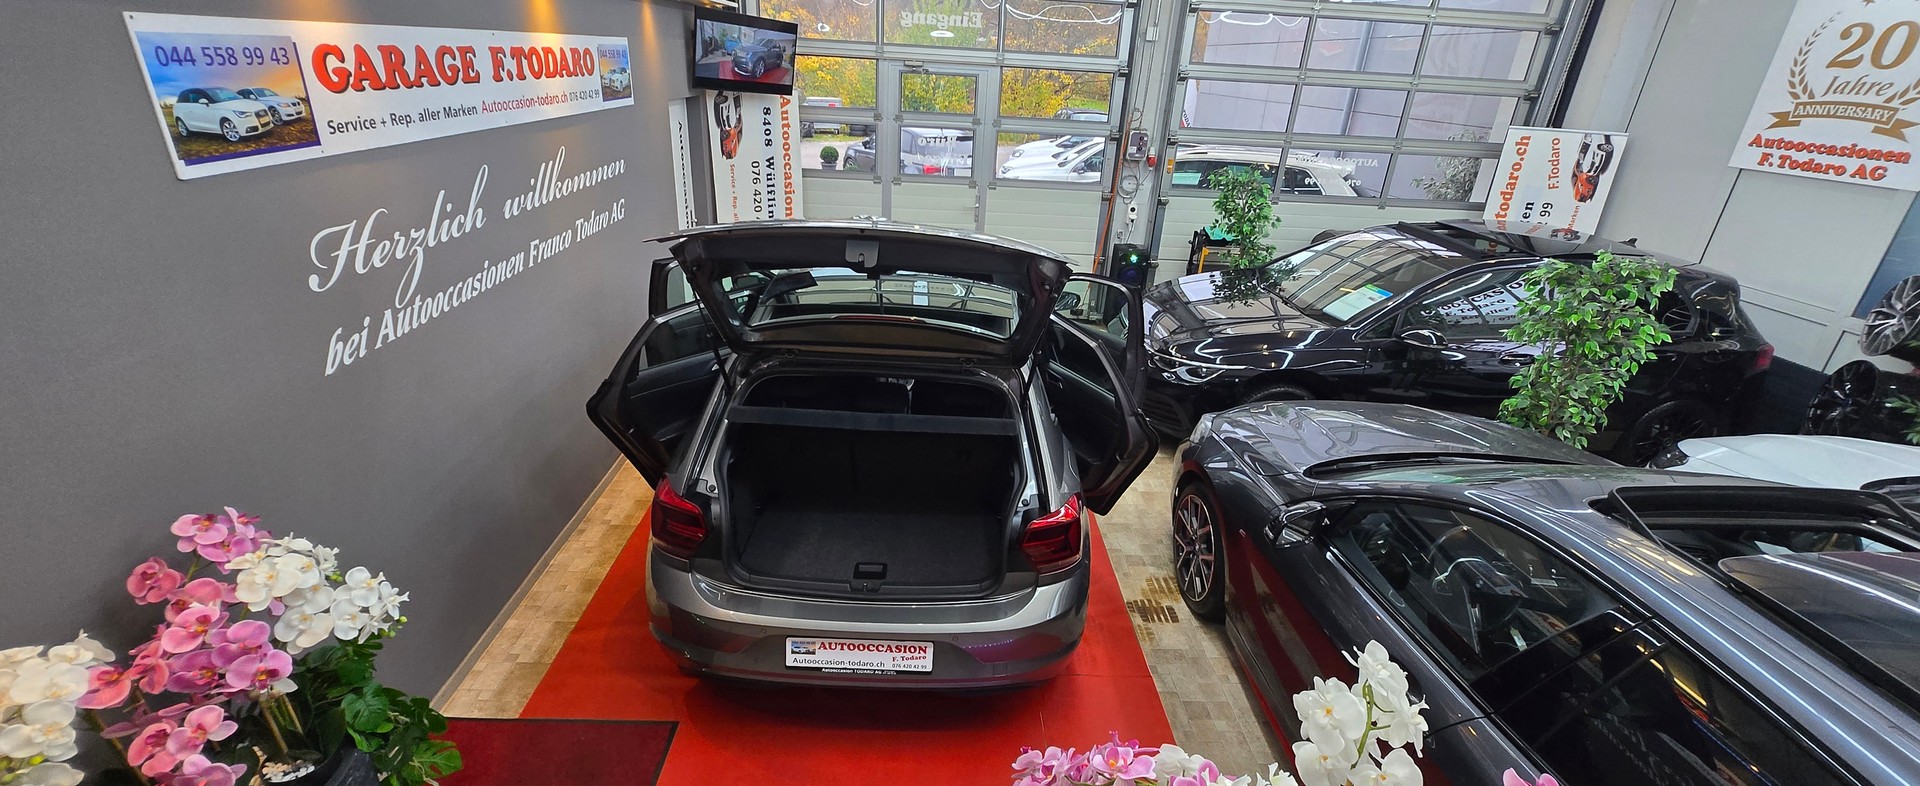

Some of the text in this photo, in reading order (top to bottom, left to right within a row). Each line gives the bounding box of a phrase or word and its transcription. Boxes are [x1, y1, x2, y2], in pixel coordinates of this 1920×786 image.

[155, 46, 291, 67] 044 558 99 43
[1826, 20, 1920, 70] 20
[311, 43, 595, 94] GARAGE F.TODARO
[1820, 74, 1894, 97] Jahre
[327, 115, 377, 135] Service
[380, 117, 387, 128] +
[390, 112, 416, 128] Rep.
[418, 108, 441, 123] aller
[443, 103, 478, 118] Marken
[482, 90, 568, 114] Autooccasion-todaro.ch
[569, 91, 578, 102] 076
[580, 90, 588, 100] 420
[588, 89, 594, 99] 42
[1793, 104, 1895, 122] ANNIVERSARY
[762, 106, 777, 219] 8408 Wülflin
[780, 96, 795, 218] Autooccasion
[1748, 133, 1912, 164] Autooccasionen
[751, 160, 761, 184] 076
[1757, 152, 1888, 181] F. Todaro AG
[753, 189, 762, 212] 420
[308, 146, 626, 309] Herzlich willkommen
[324, 198, 626, 377] bei Autooccasionen Franco Todaro AG
[792, 657, 885, 668] Autooccasion-todaro.ch
[818, 641, 928, 655] AUTOOCCASION
